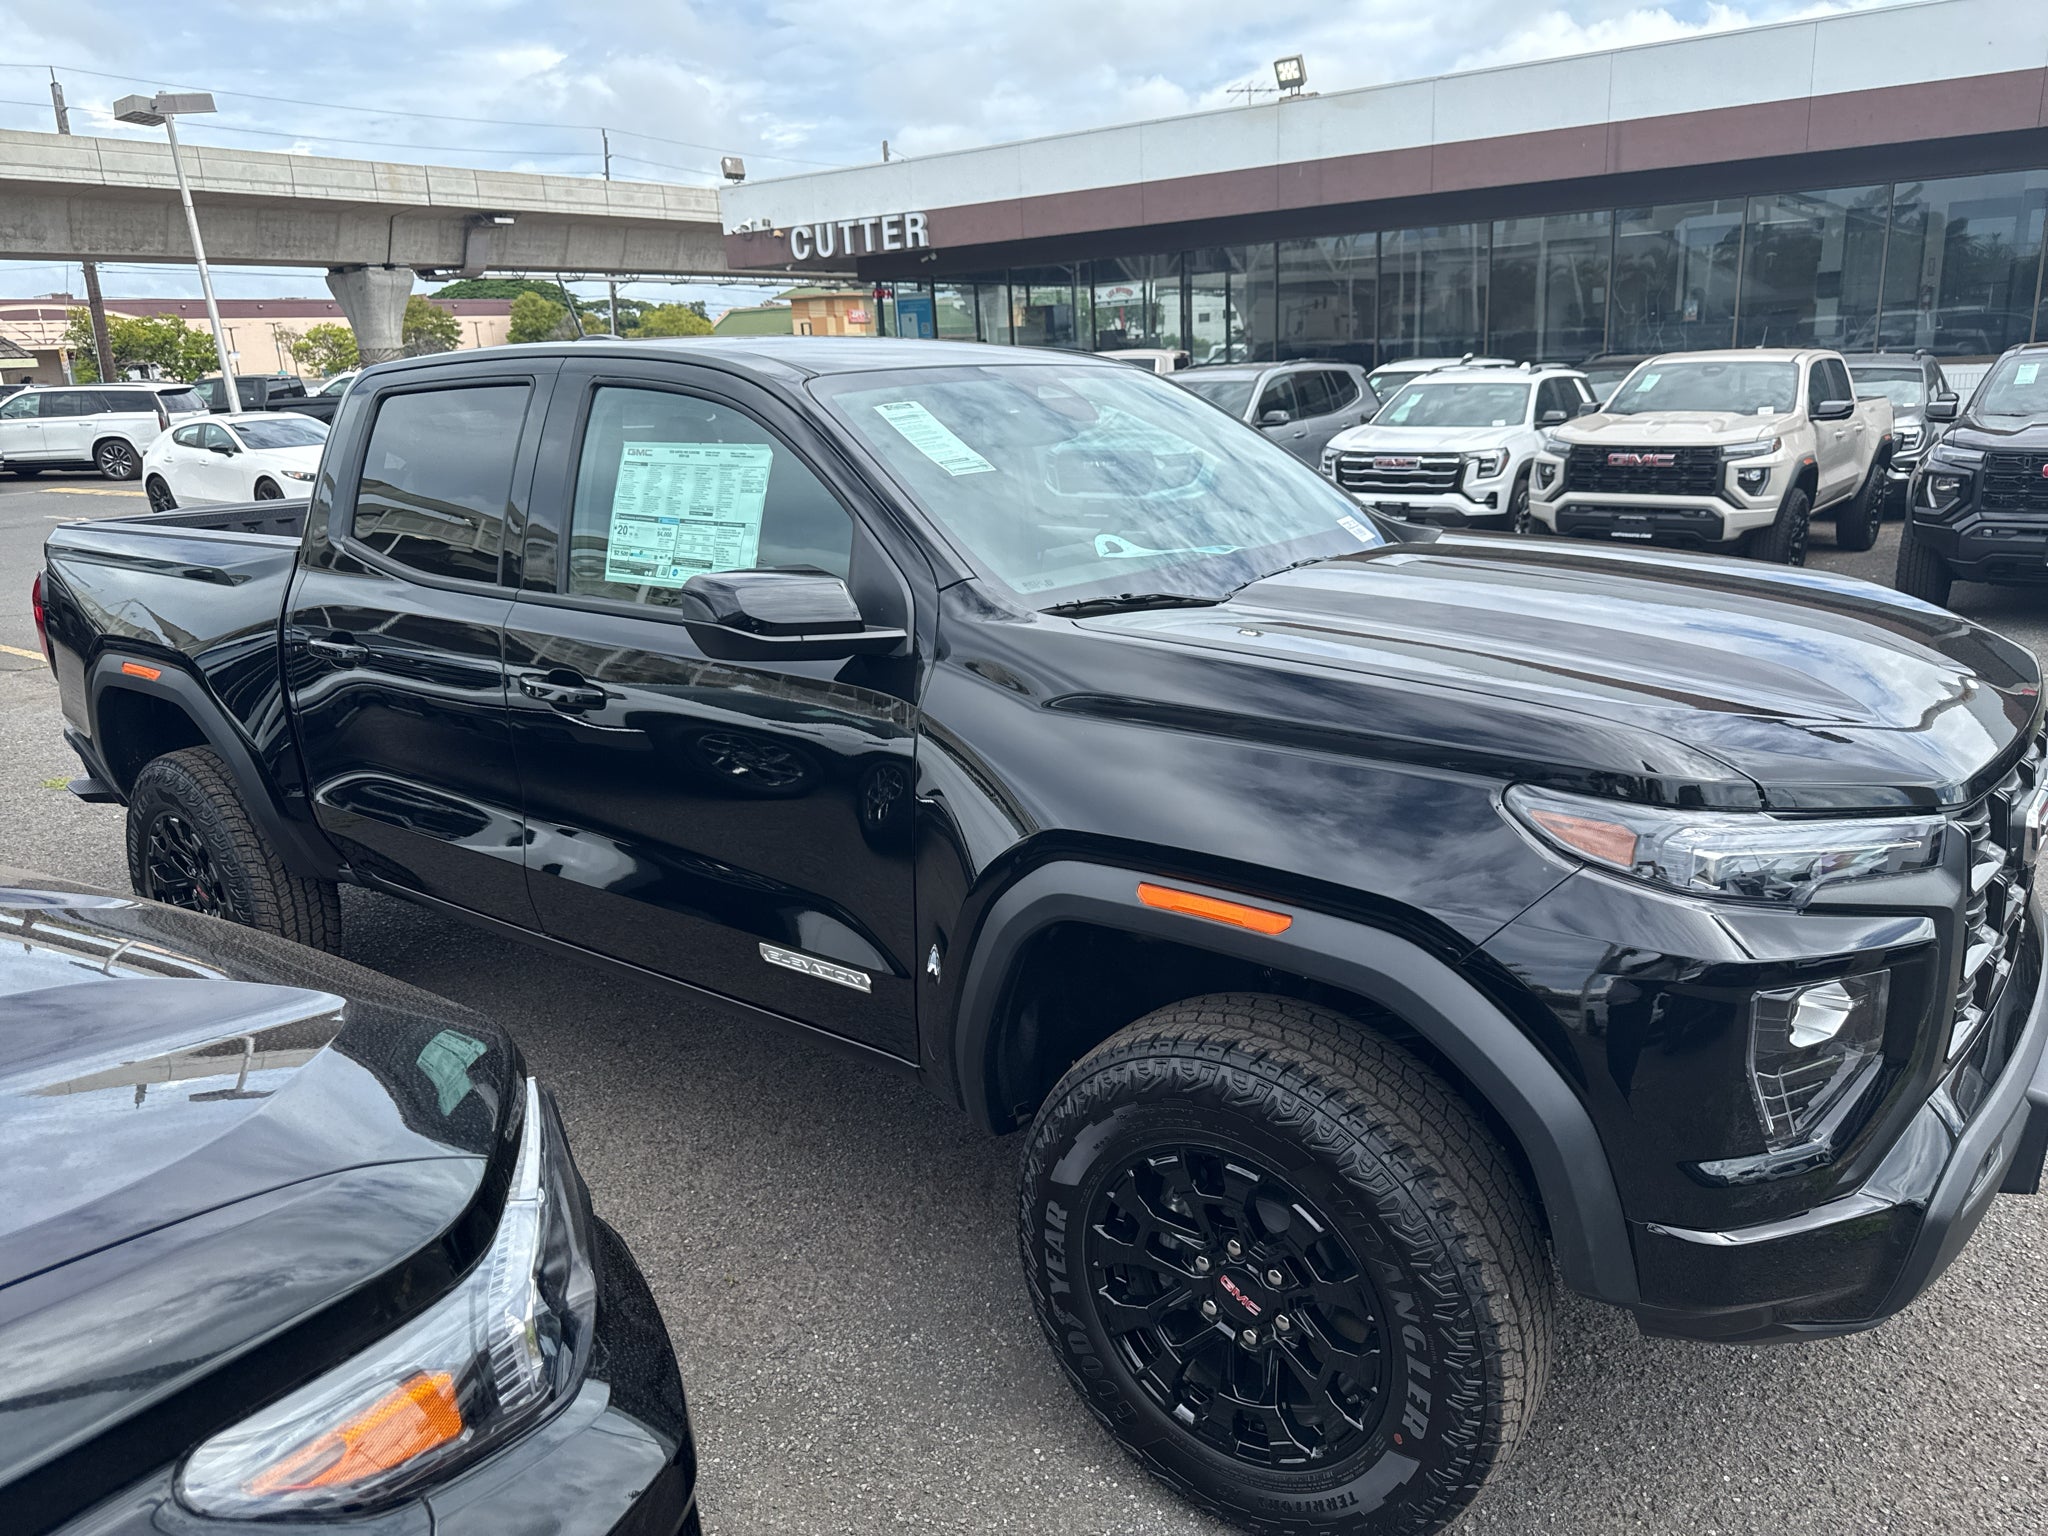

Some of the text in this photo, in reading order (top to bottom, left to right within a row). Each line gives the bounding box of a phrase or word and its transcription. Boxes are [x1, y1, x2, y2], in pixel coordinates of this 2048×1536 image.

[790, 212, 929, 261] CUTTER
[627, 448, 653, 457] GMC
[1374, 456, 1419, 469] GMC
[1607, 453, 1676, 468] GMC
[617, 524, 628, 536] 20
[767, 949, 863, 985] ELEVATION
[1220, 1274, 1262, 1316] GMC
